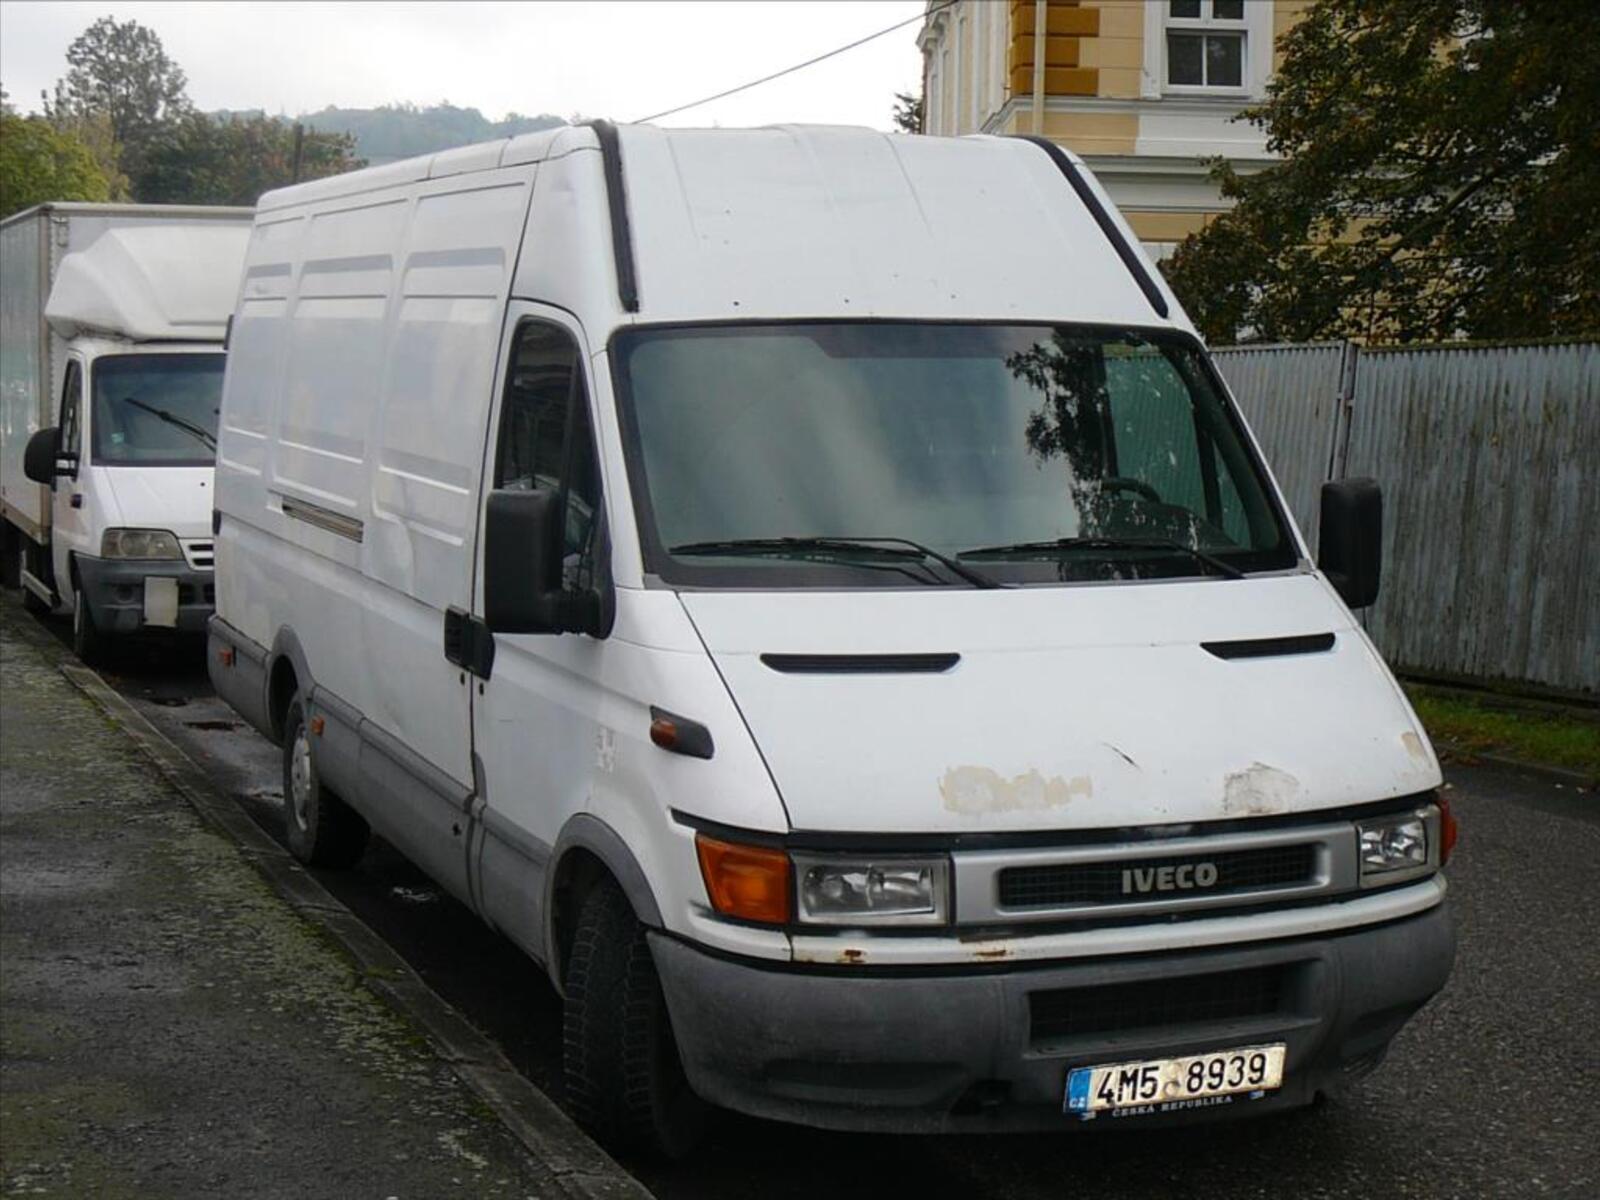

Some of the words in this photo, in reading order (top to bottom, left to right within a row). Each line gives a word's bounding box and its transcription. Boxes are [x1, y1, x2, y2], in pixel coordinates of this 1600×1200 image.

[1122, 862, 1218, 894] IVECO
[1097, 1066, 1159, 1104] 4M5
[1186, 1053, 1266, 1094] 8939
[1161, 1095, 1232, 1112] REPUBLIKA
